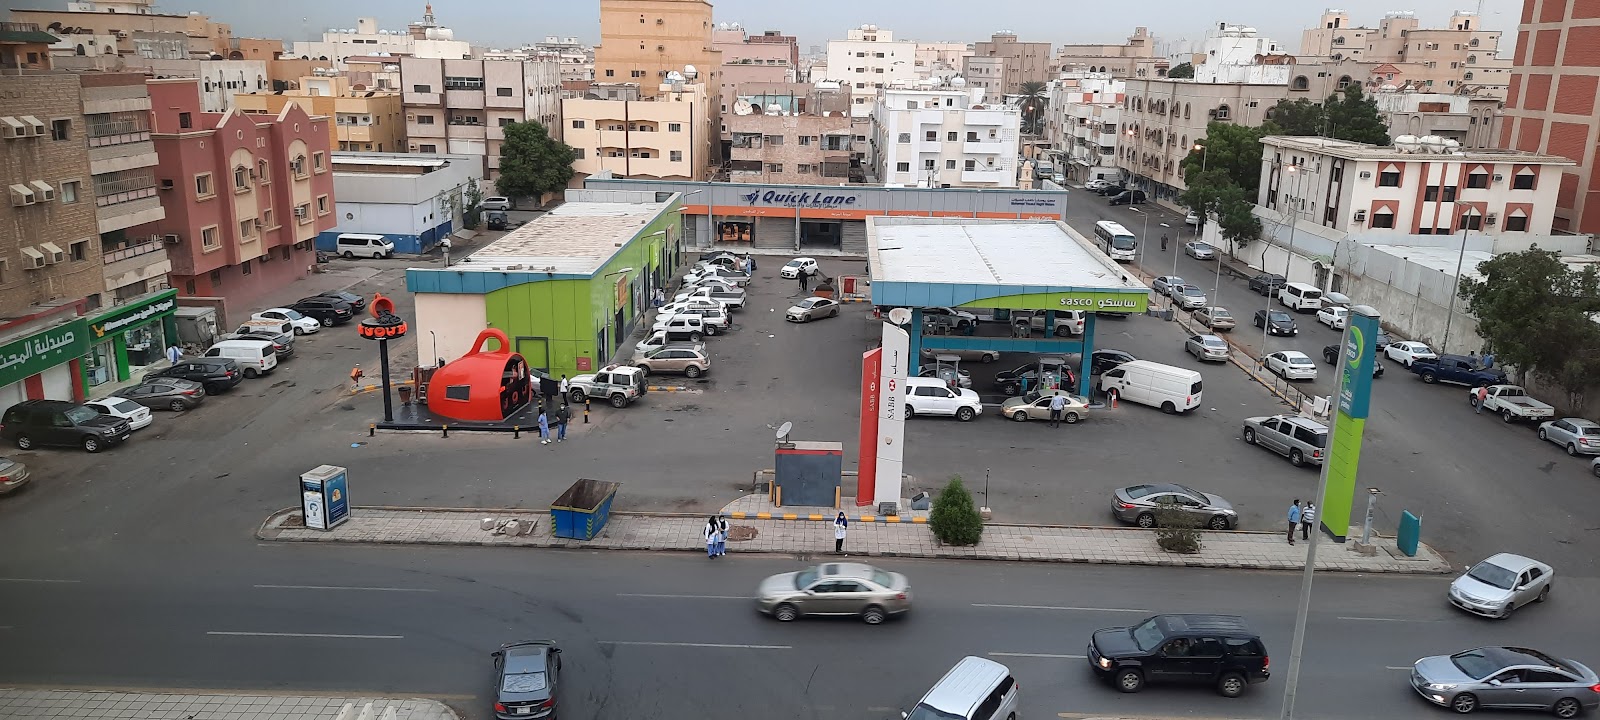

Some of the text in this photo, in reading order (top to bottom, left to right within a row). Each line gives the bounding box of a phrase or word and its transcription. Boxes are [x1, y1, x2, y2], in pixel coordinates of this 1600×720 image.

[762, 190, 856, 204] Quick Lane
[1060, 297, 1093, 306] sasco
[1097, 298, 1137, 309] ساسكو
[34, 331, 75, 360] صيدلية
[887, 396, 896, 420] SABB
